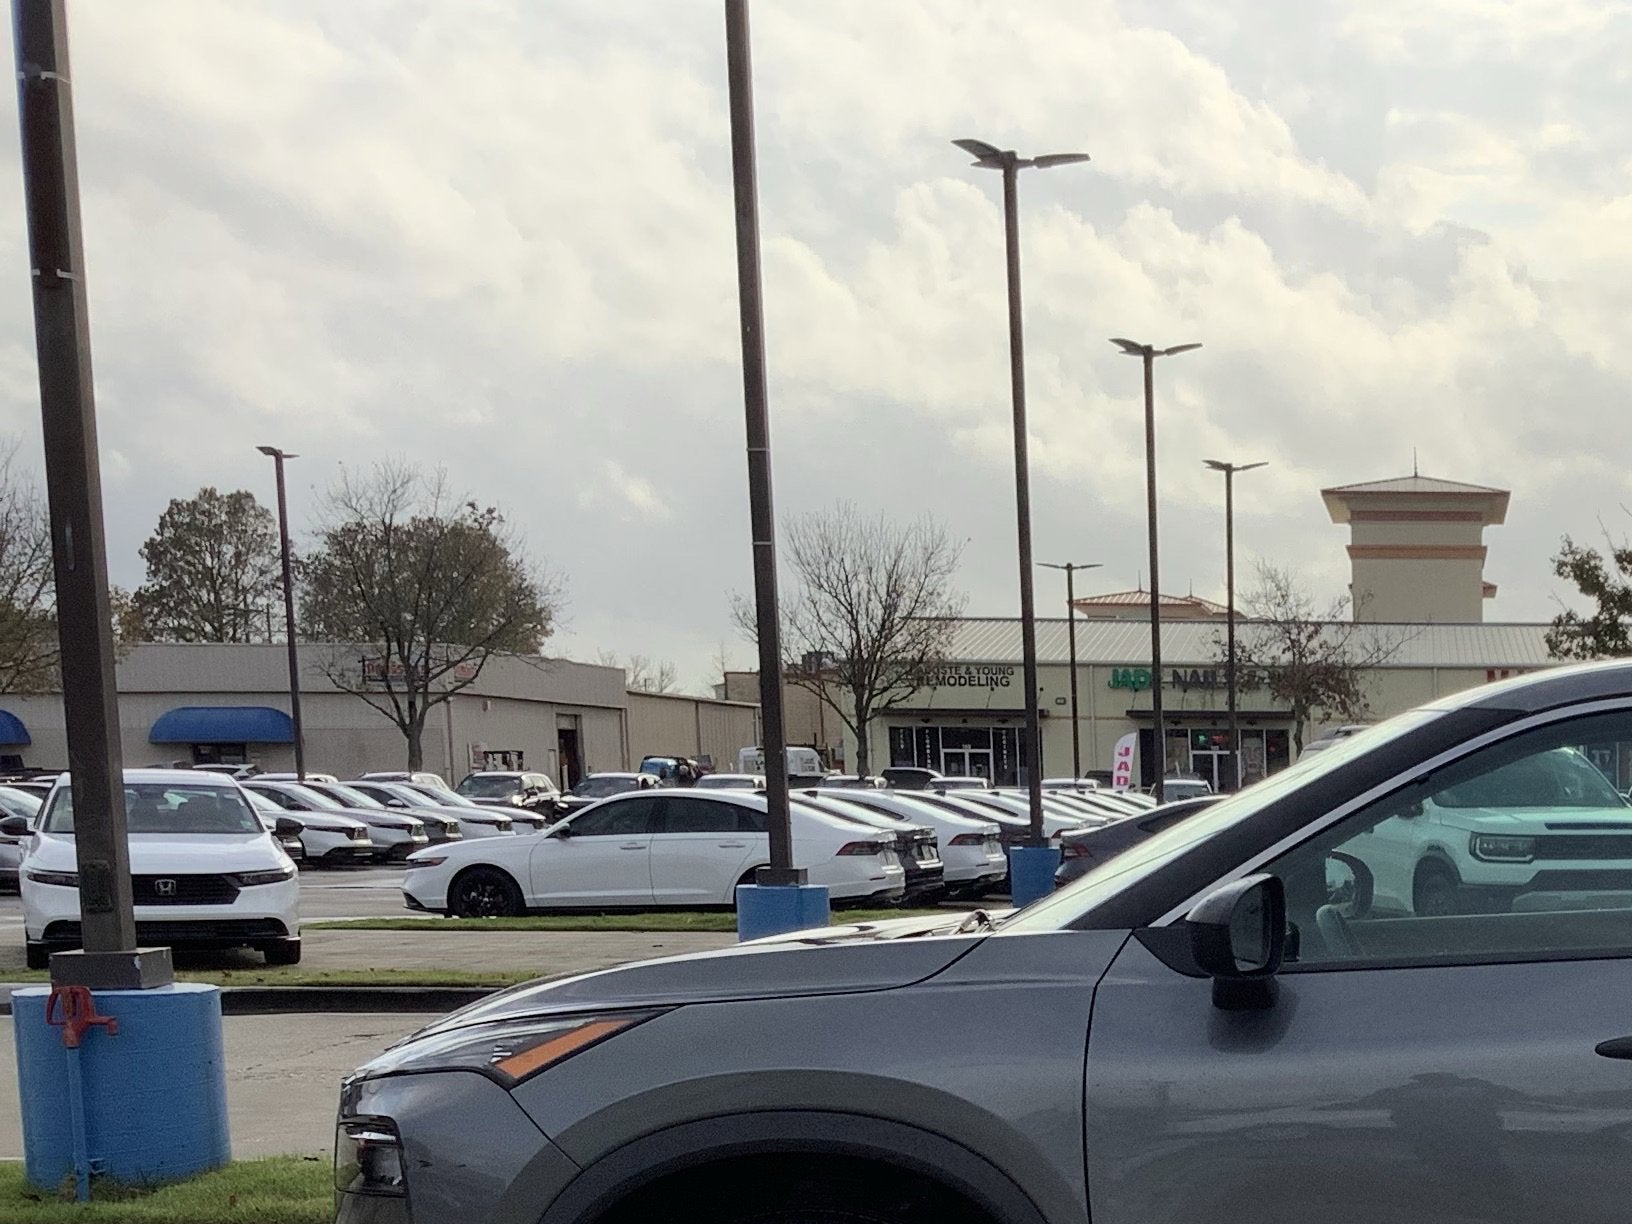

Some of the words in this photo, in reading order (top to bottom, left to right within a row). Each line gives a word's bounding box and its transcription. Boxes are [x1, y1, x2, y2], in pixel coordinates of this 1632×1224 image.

[964, 667, 972, 676] &
[975, 666, 1014, 676] YOUNG
[917, 675, 1010, 687] REMODELING
[1108, 669, 1163, 689] JAD
